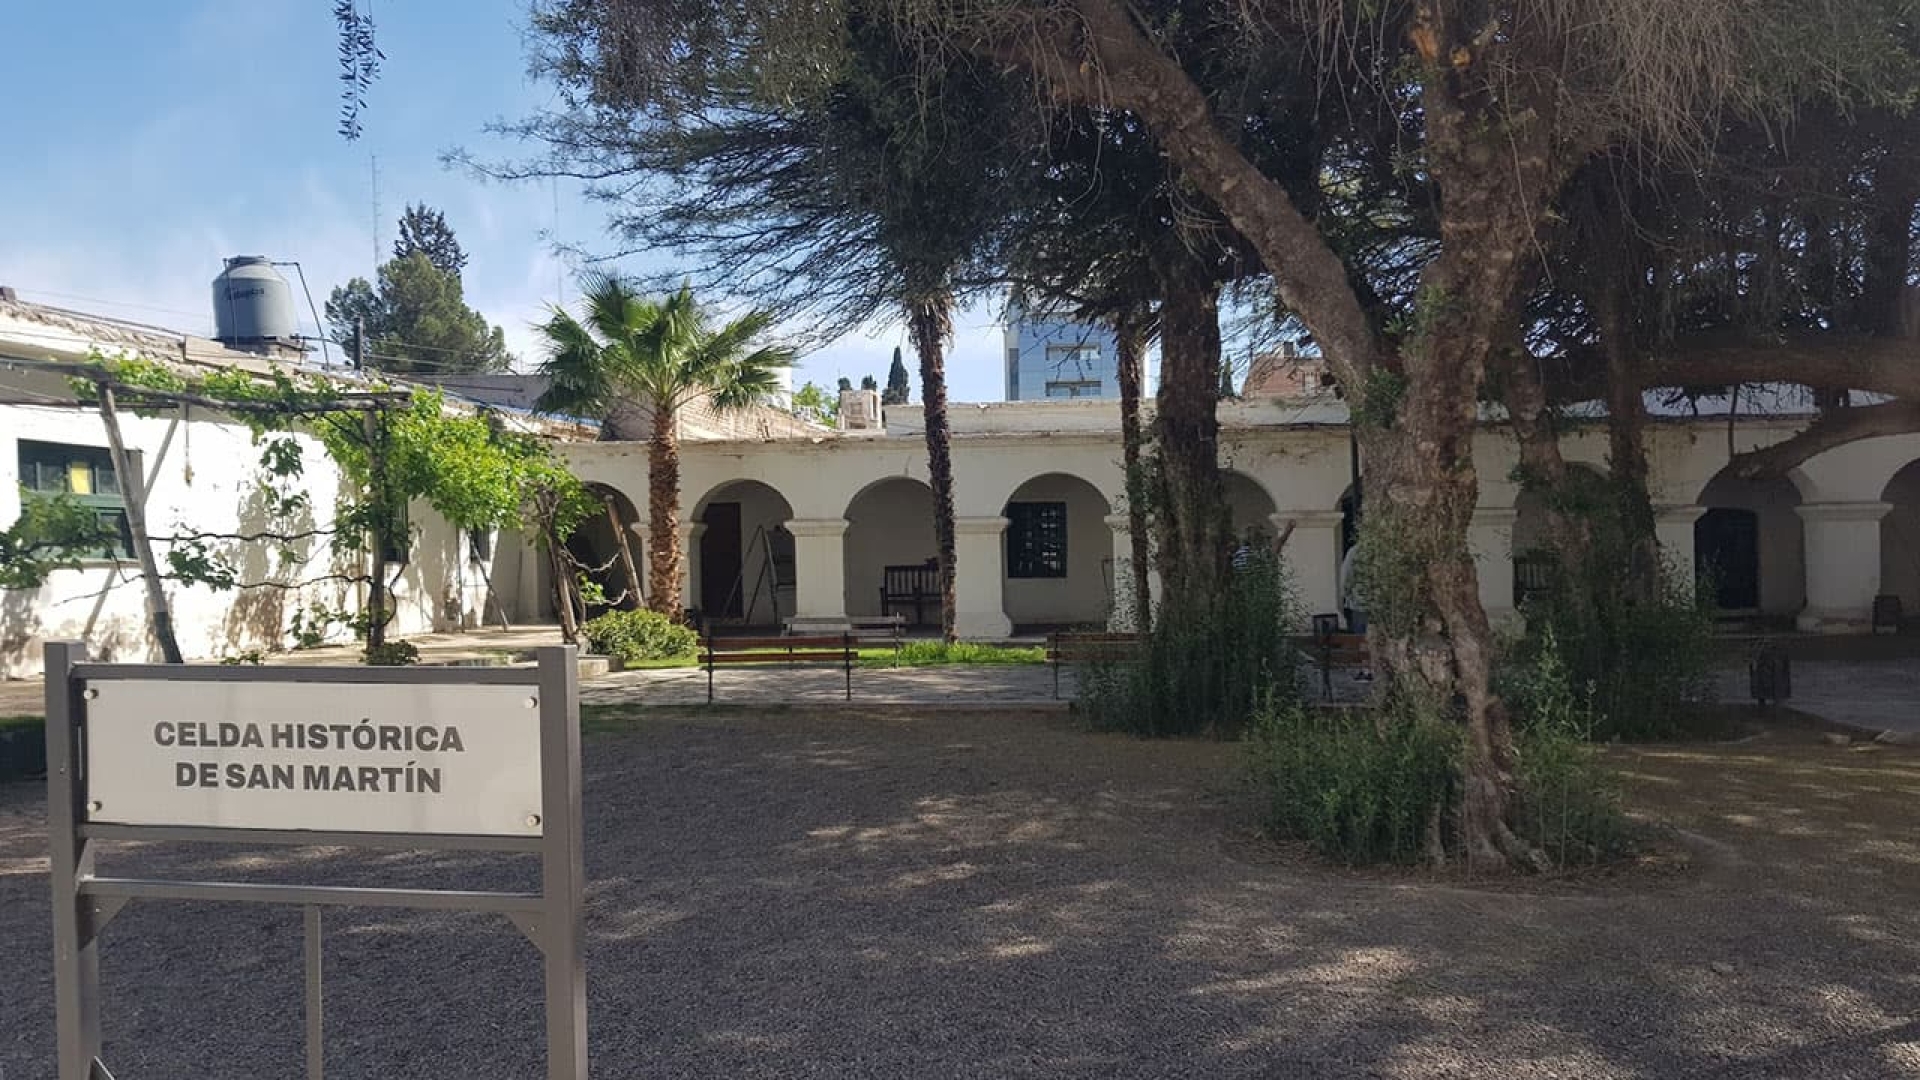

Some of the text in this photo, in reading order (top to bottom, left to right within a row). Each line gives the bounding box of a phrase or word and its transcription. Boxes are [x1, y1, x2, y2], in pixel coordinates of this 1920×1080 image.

[154, 718, 465, 752] CELDA HISTÓRICA
[175, 760, 441, 793] DE SAN MARTÍN
